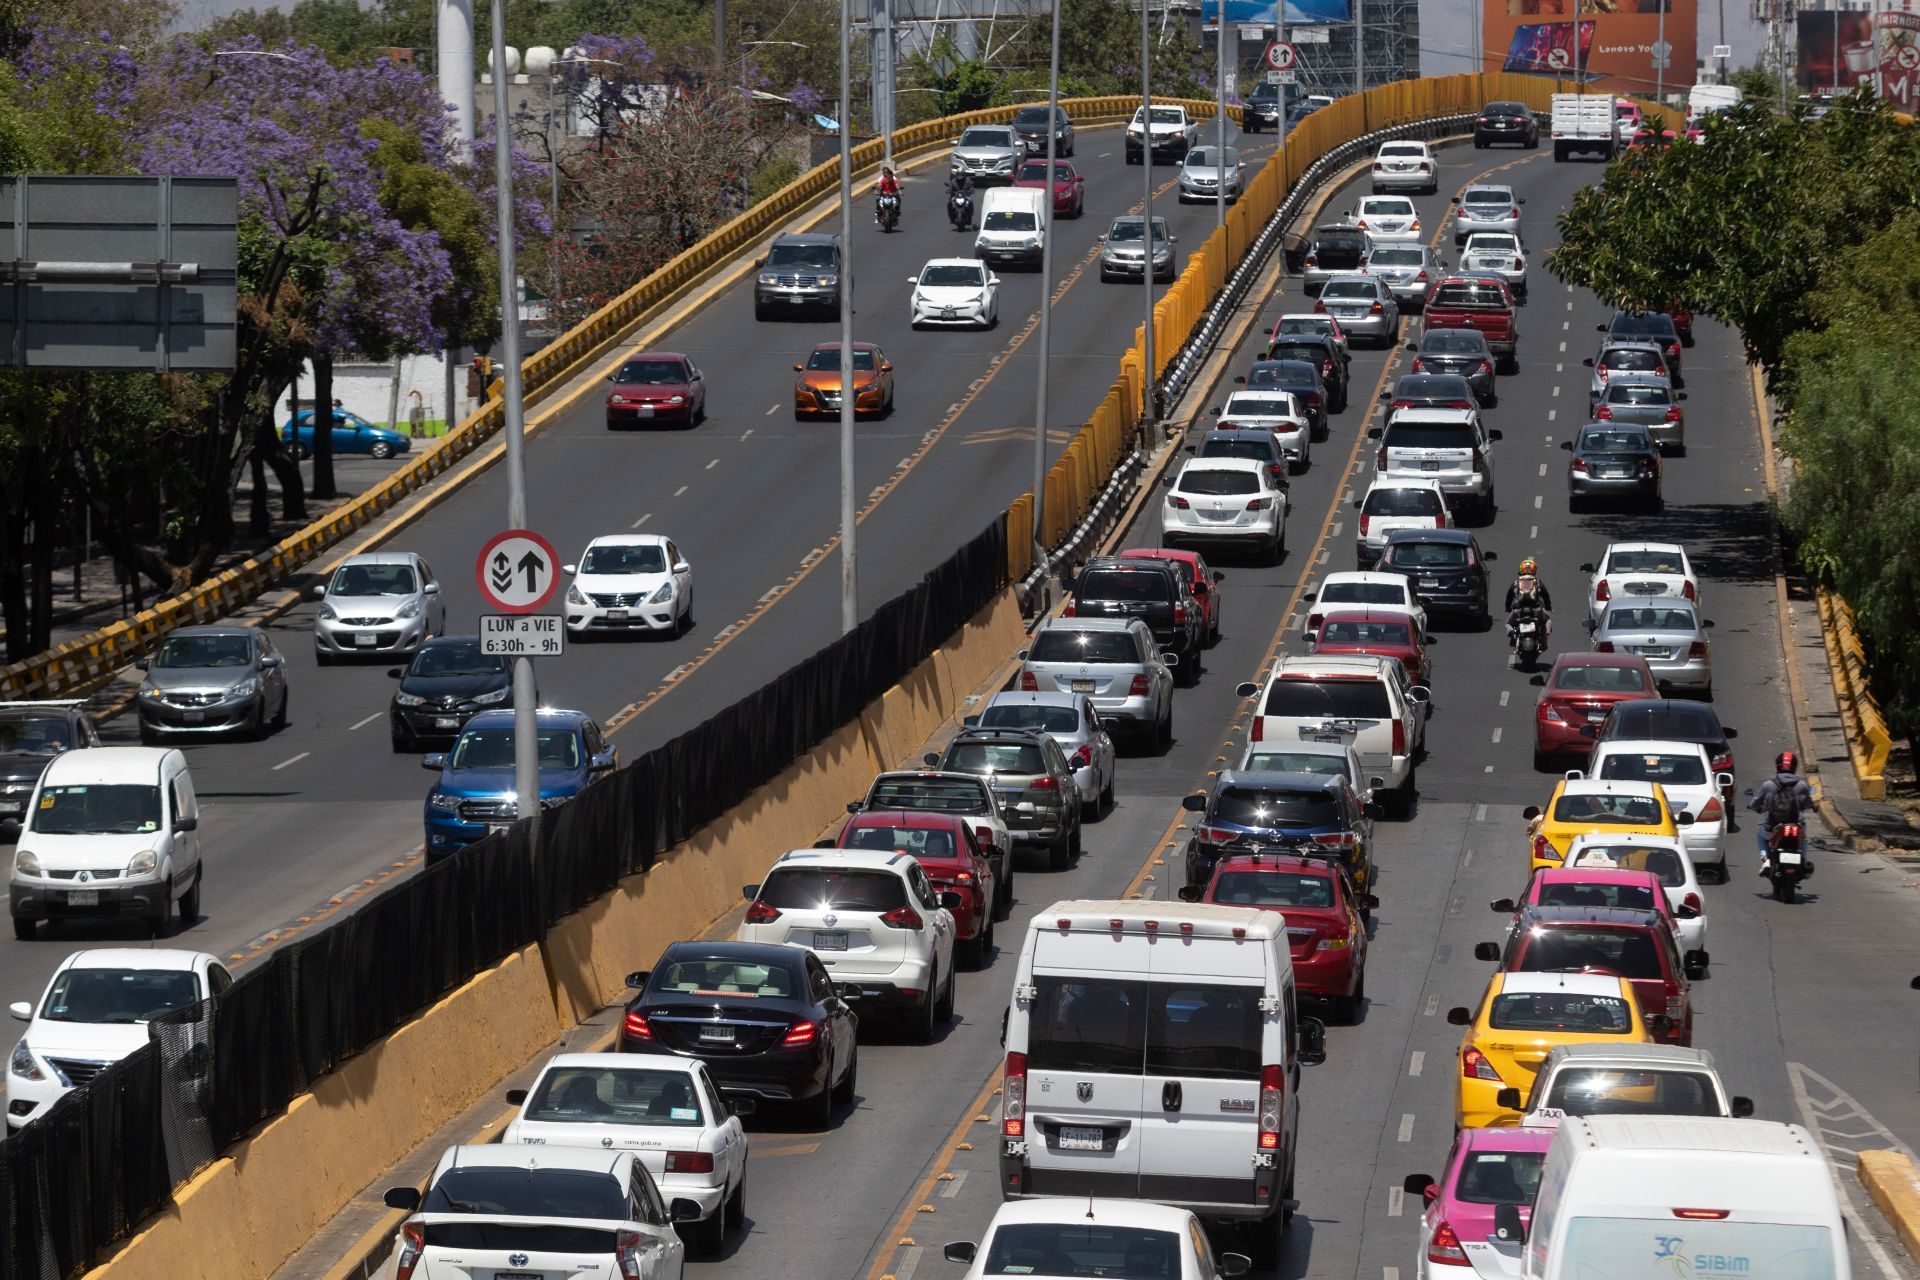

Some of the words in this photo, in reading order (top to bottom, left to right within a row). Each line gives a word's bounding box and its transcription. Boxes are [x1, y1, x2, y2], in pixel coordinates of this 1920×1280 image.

[1599, 45, 1635, 53] Lenovo
[488, 619, 515, 632] LUN
[521, 621, 529, 632] a
[534, 619, 556, 632] VIE
[486, 638, 525, 652] 6:30h
[542, 638, 558, 652] 9h
[1538, 1108, 1562, 1119] TAXI
[624, 1139, 662, 1147] cdmx.gob.mx
